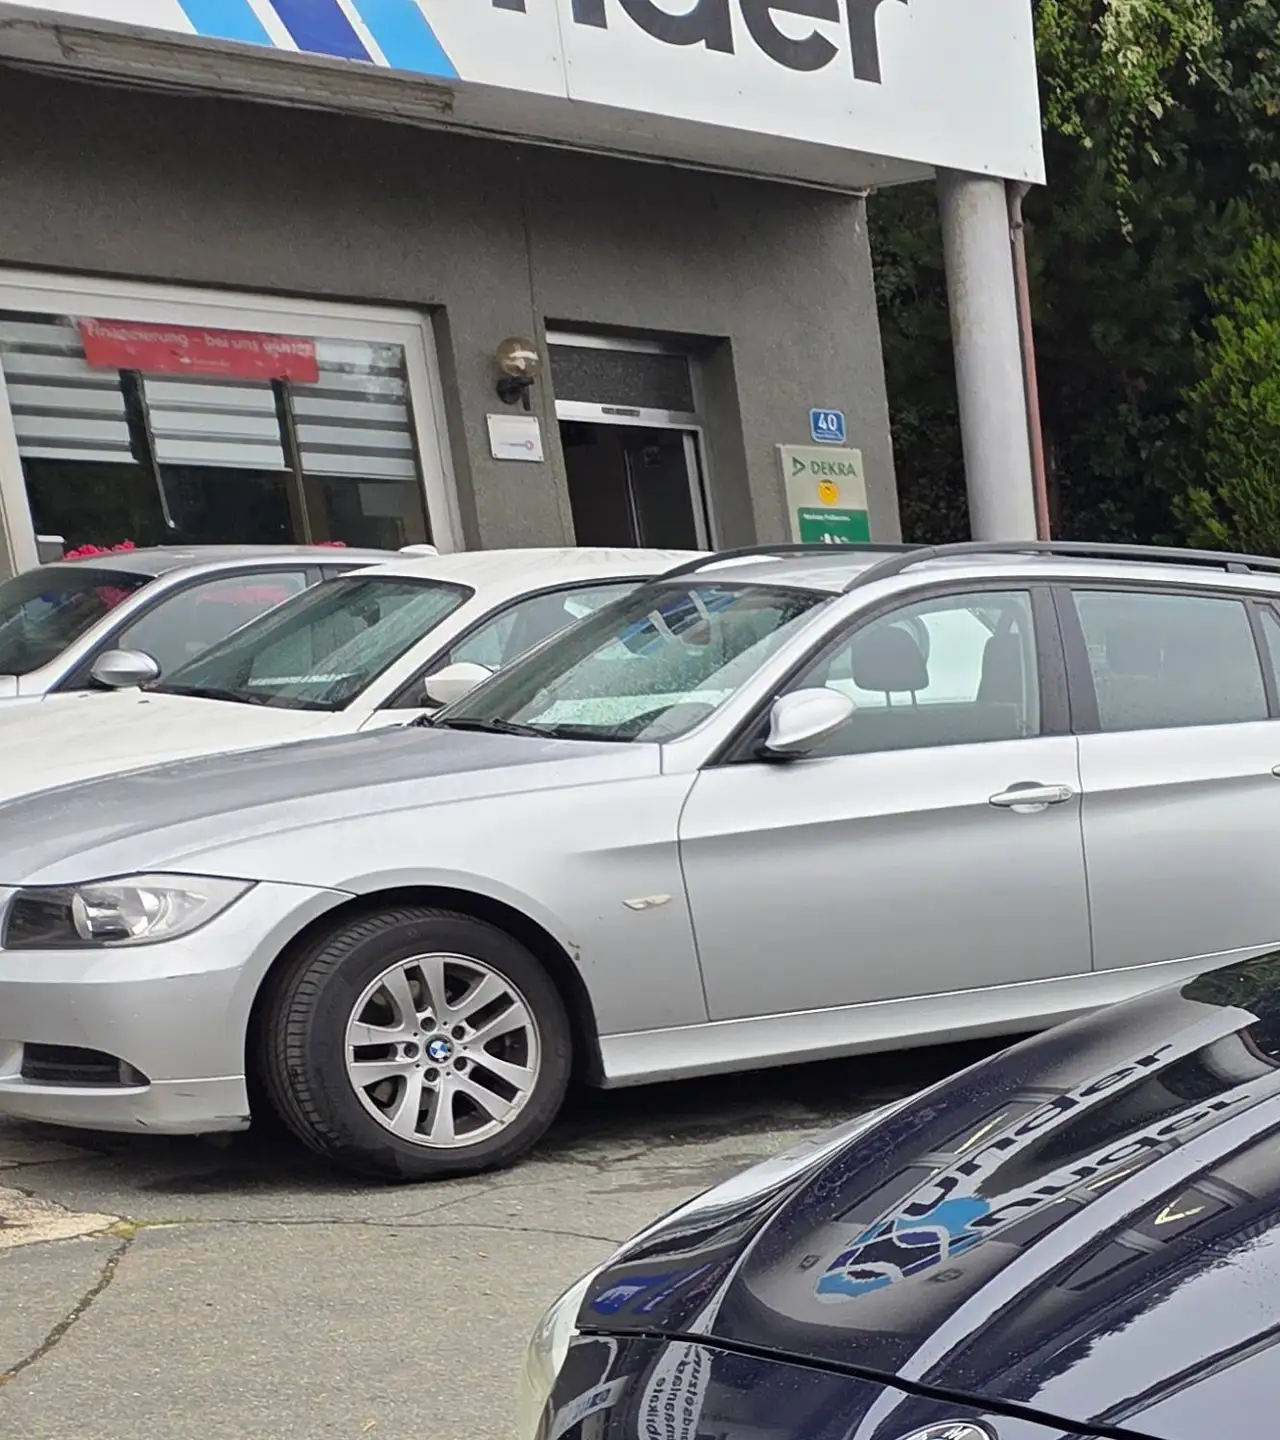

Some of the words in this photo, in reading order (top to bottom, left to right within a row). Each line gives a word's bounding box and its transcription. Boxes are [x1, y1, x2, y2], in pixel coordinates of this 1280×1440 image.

[492, 0, 908, 85] er
[818, 412, 837, 431] 40
[810, 460, 857, 478] DEKRA
